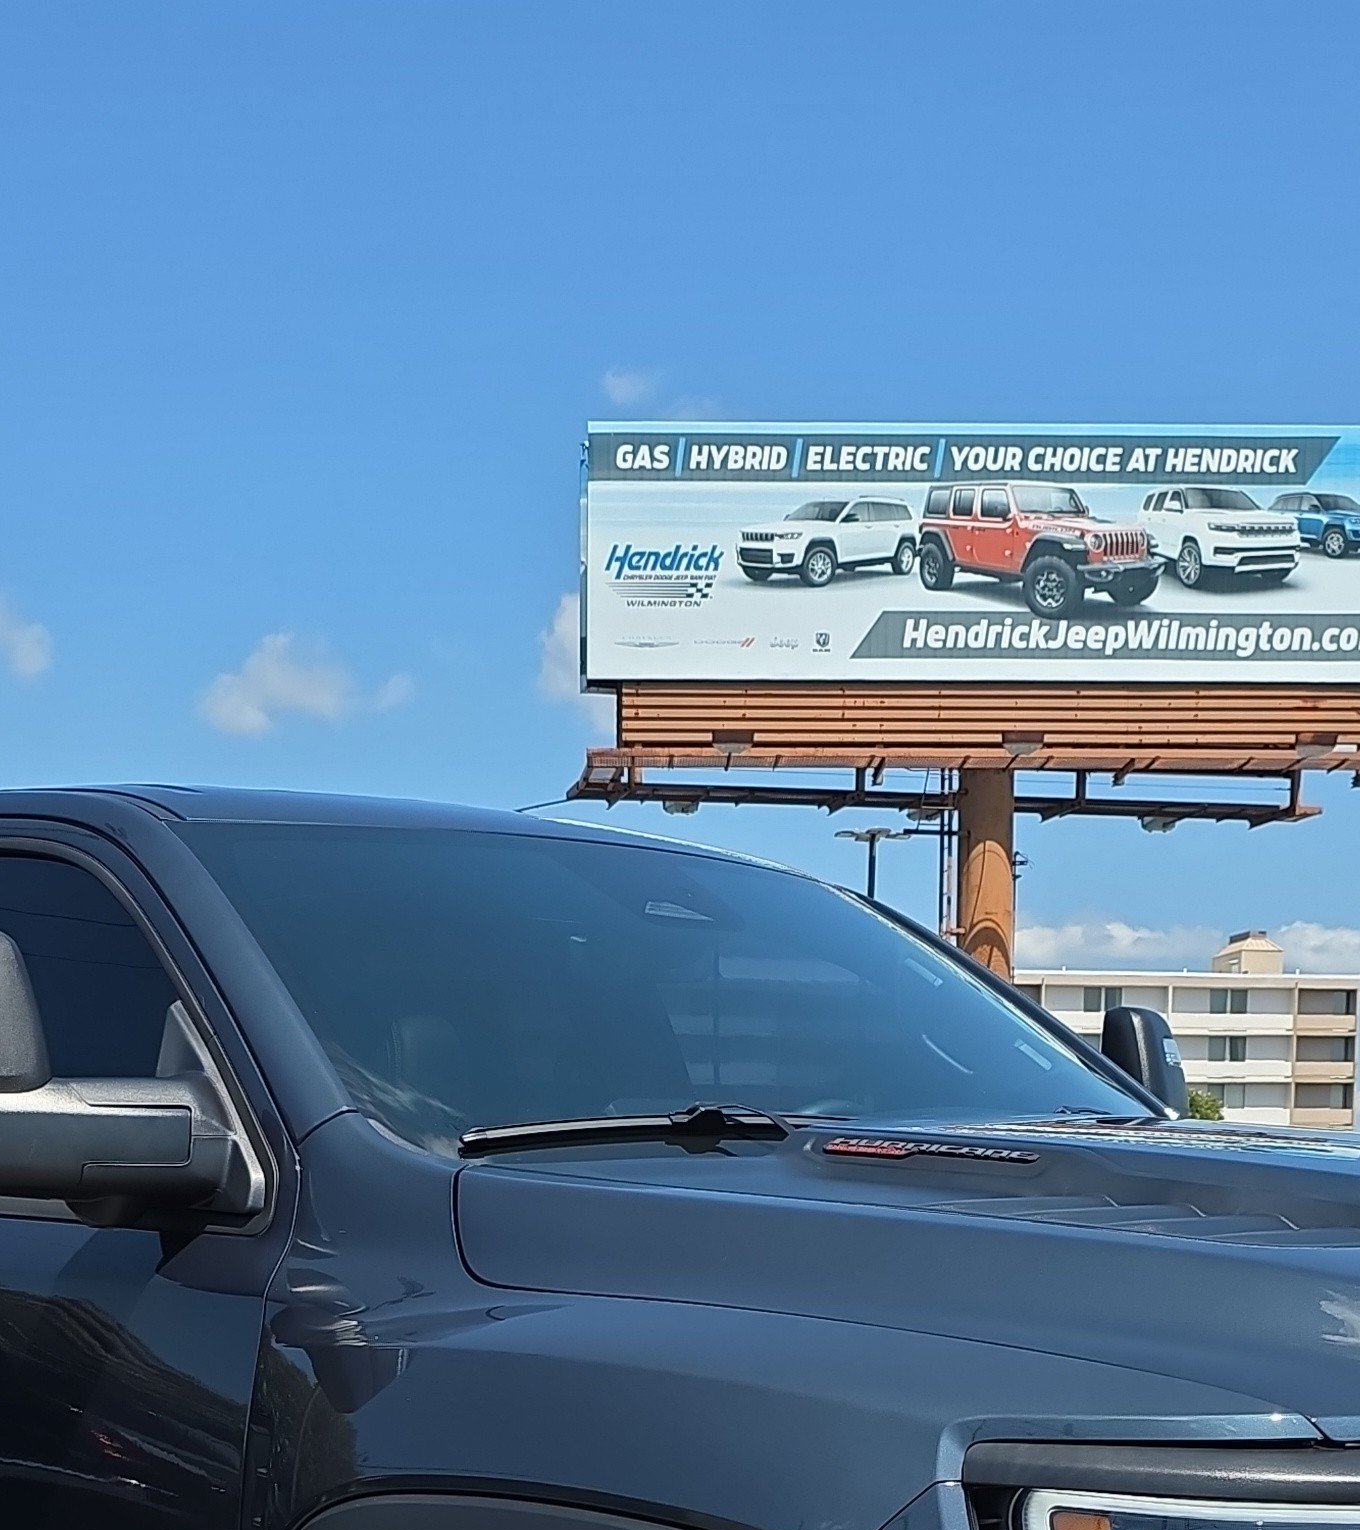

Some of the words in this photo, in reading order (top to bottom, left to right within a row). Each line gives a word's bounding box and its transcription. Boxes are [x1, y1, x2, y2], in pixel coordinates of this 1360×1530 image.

[615, 443, 670, 471] GAS
[689, 444, 788, 472] HYBRID
[806, 446, 931, 472] ELECTRIC
[951, 446, 1021, 473] YOUR
[1027, 446, 1122, 473] CHOICE
[1126, 447, 1162, 473] AT
[1165, 447, 1299, 474] HENDRICK
[604, 544, 724, 580] Hendrick
[831, 1136, 1041, 1162] HURRICANE
